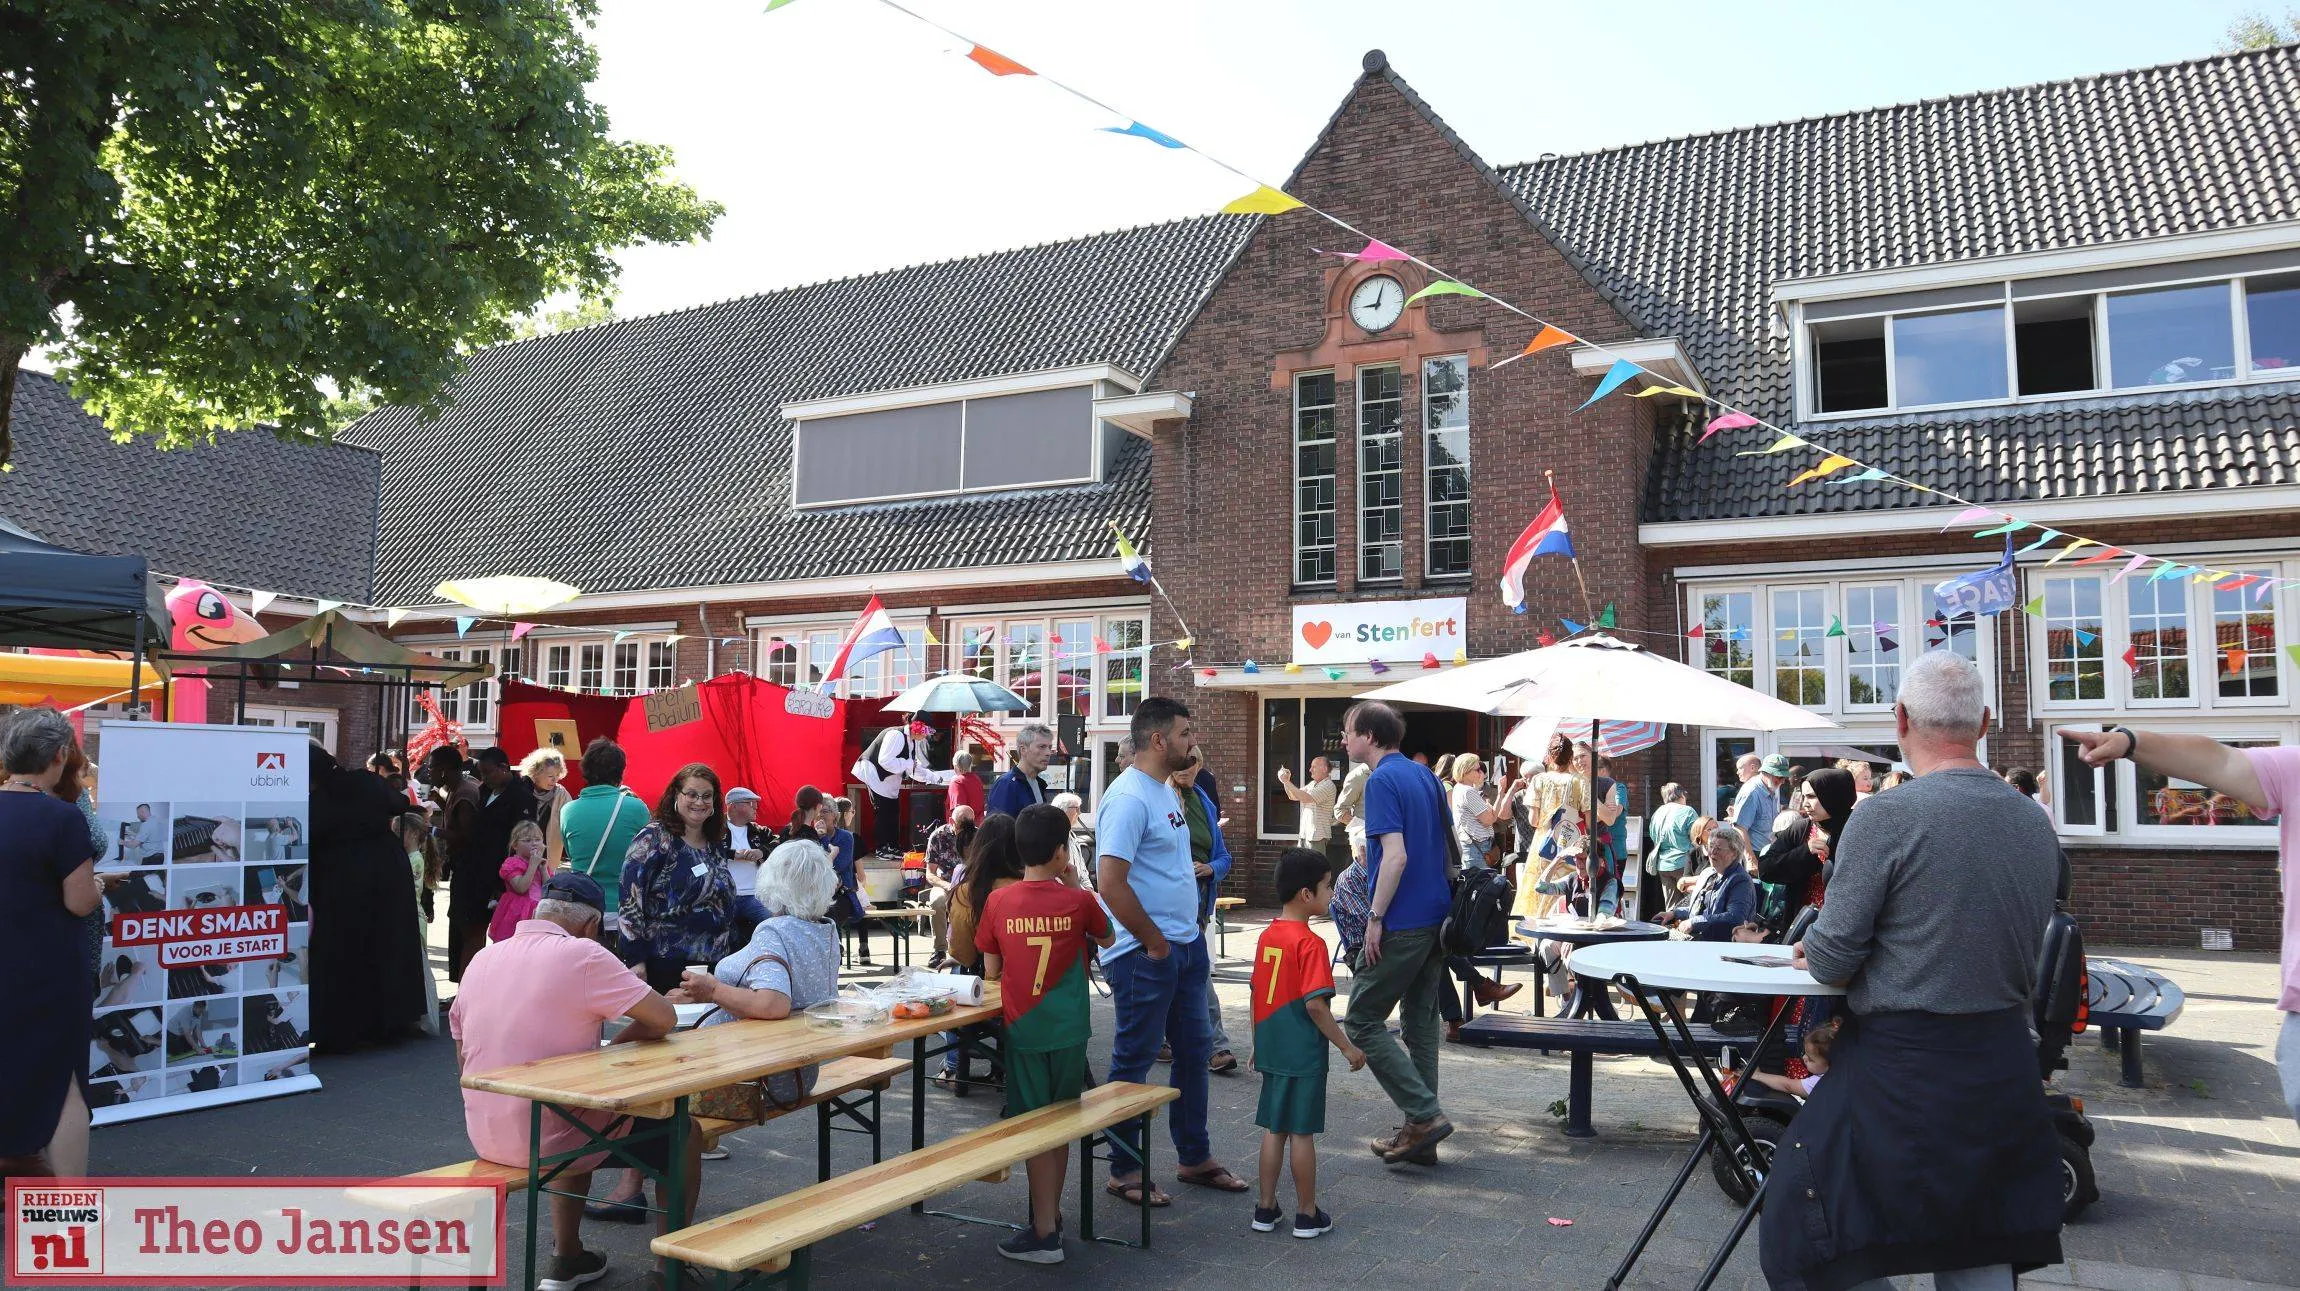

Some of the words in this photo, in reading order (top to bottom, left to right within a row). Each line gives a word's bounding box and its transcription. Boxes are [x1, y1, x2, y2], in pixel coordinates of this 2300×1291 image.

[1356, 617, 1457, 643] Stenfert
[250, 774, 289, 787] ubbink
[121, 915, 195, 941] DENK
[200, 909, 281, 935] SMART
[1006, 916, 1072, 934] RONALDO
[168, 944, 213, 960] VOOR
[217, 942, 232, 956] JE
[236, 938, 279, 954] START
[1026, 936, 1052, 996] 7
[1262, 946, 1283, 1005] 7
